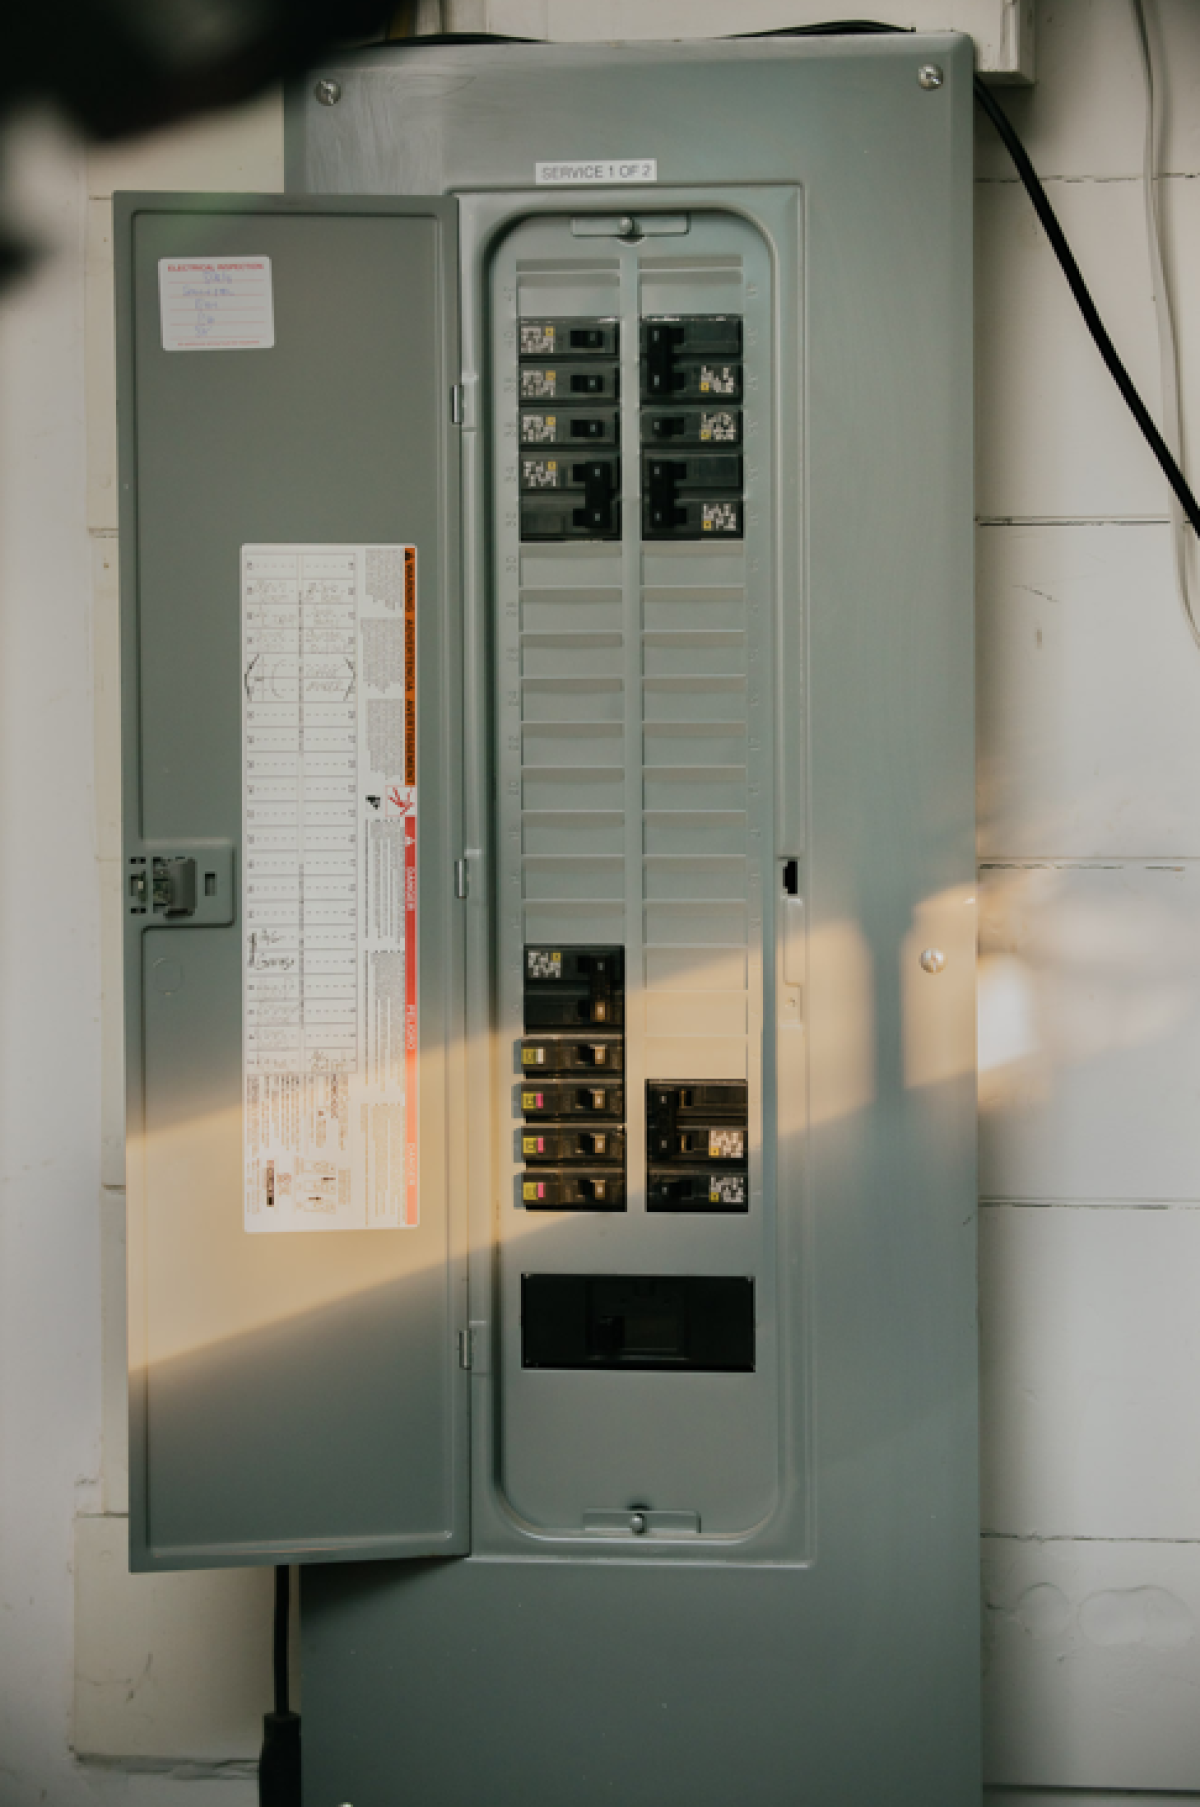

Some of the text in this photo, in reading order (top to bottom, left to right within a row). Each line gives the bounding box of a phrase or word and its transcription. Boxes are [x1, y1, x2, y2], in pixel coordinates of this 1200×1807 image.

[541, 164, 603, 181] SERVICE
[618, 164, 639, 179] OF
[641, 163, 653, 177] 2
